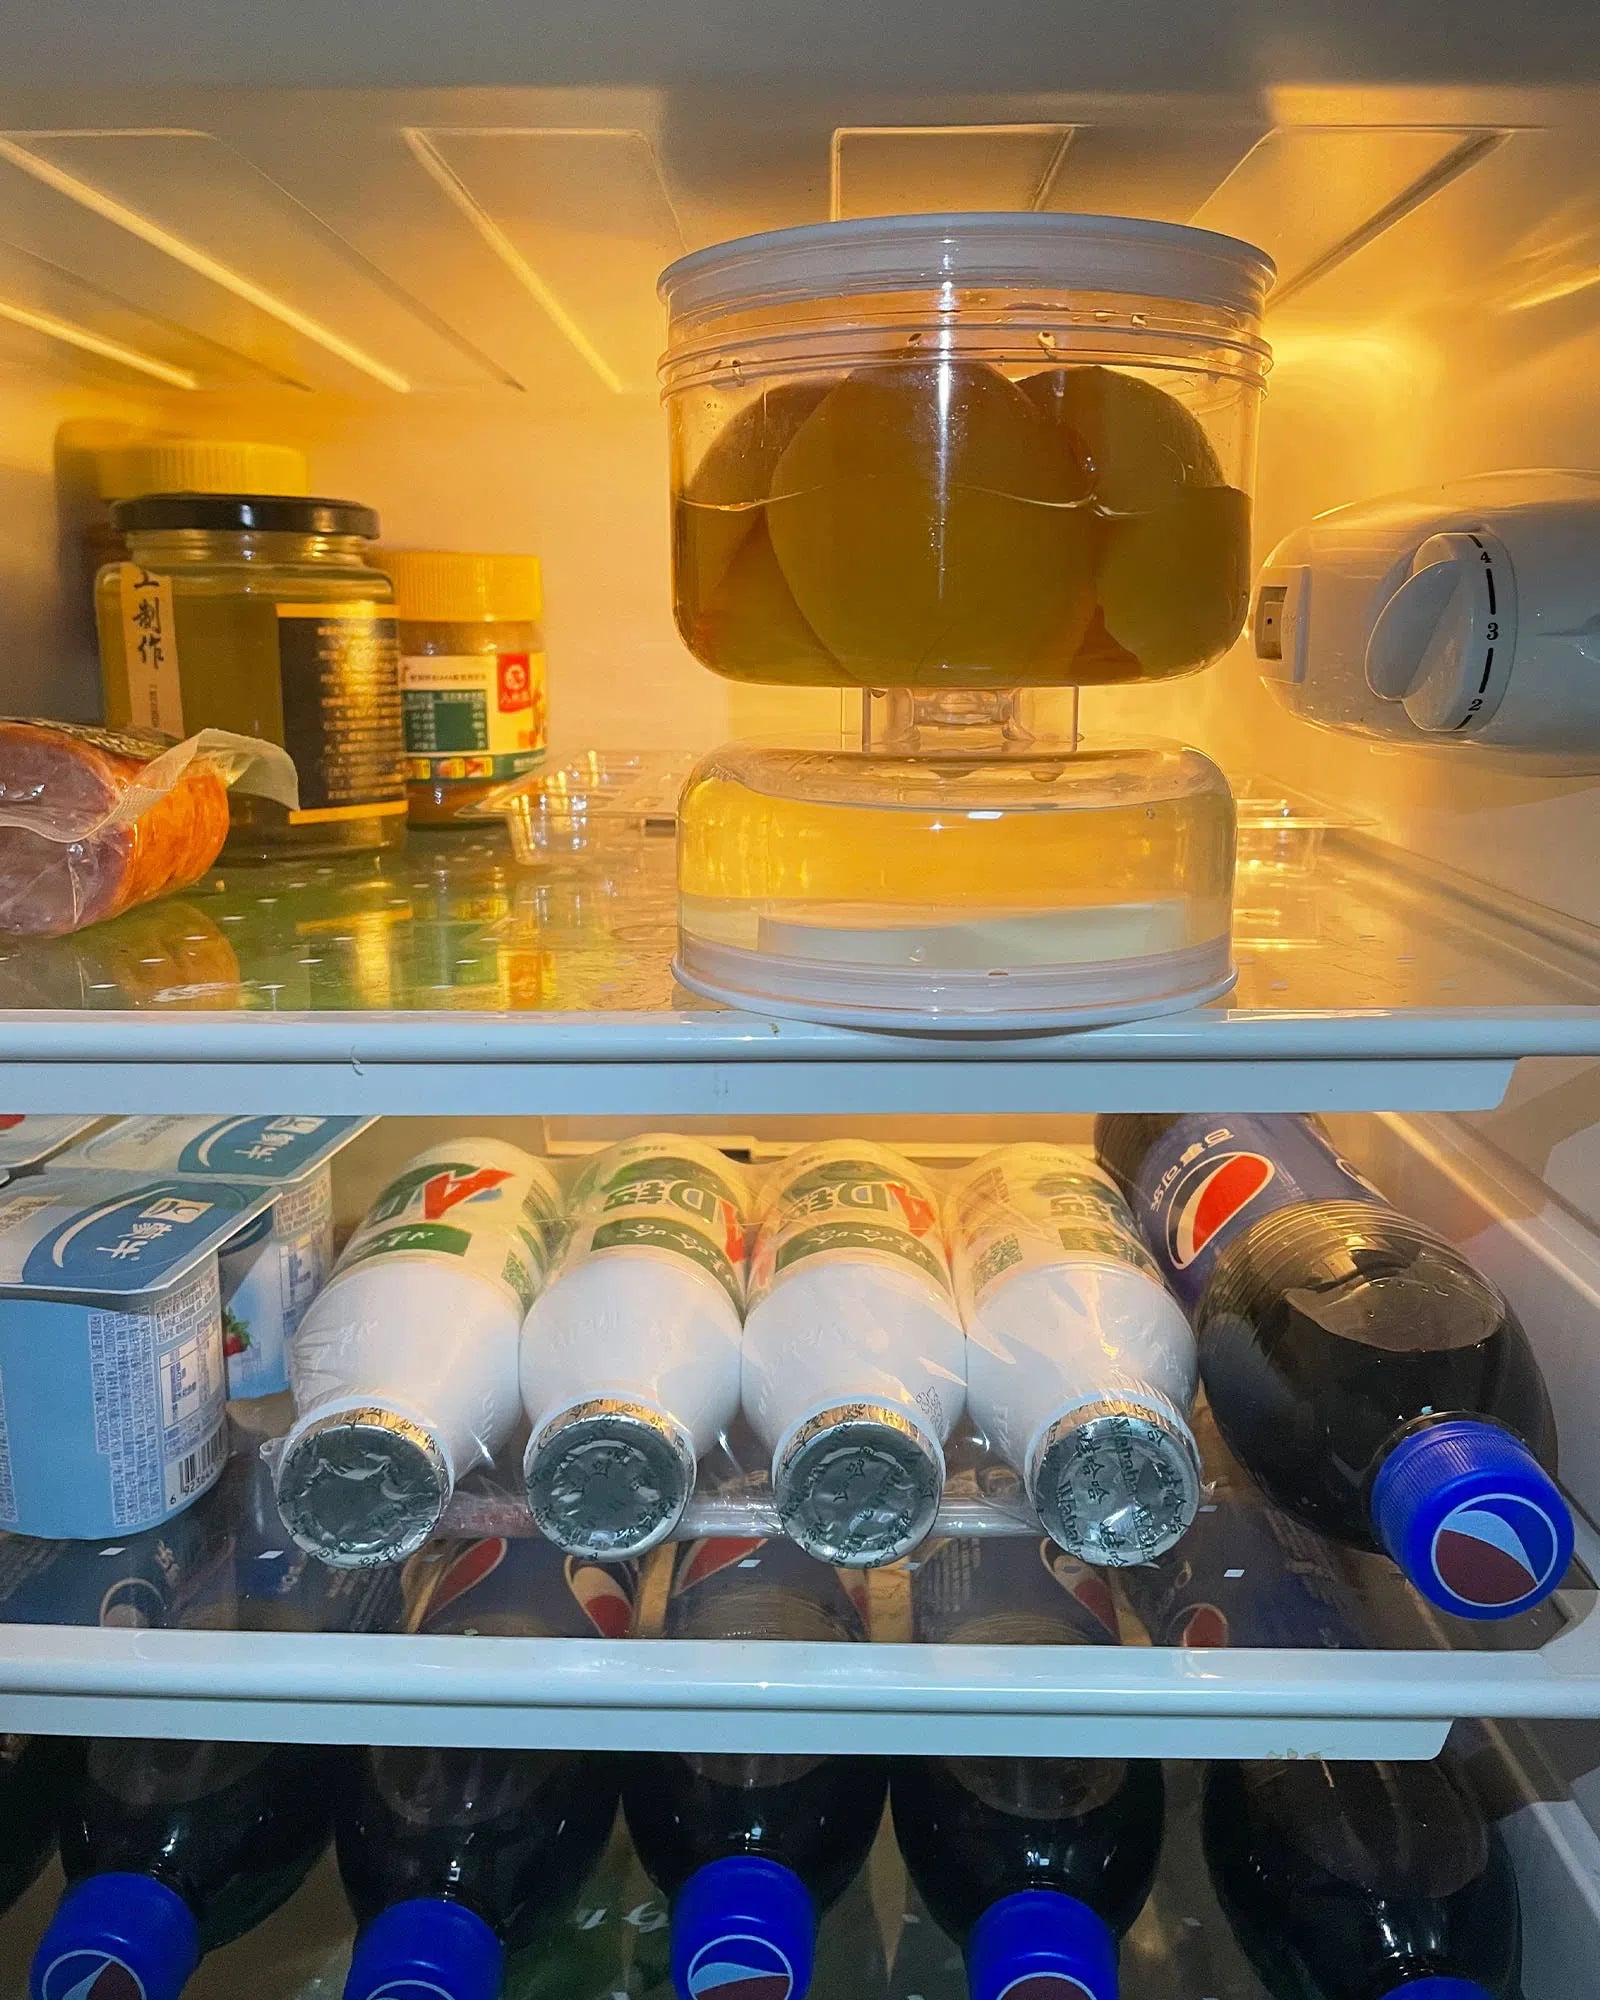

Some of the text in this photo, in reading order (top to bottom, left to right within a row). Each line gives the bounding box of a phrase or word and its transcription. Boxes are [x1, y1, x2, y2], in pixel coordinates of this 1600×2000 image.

[1480, 551, 1492, 564] 4
[1487, 622, 1499, 641] 3
[1468, 698, 1483, 712] 2
